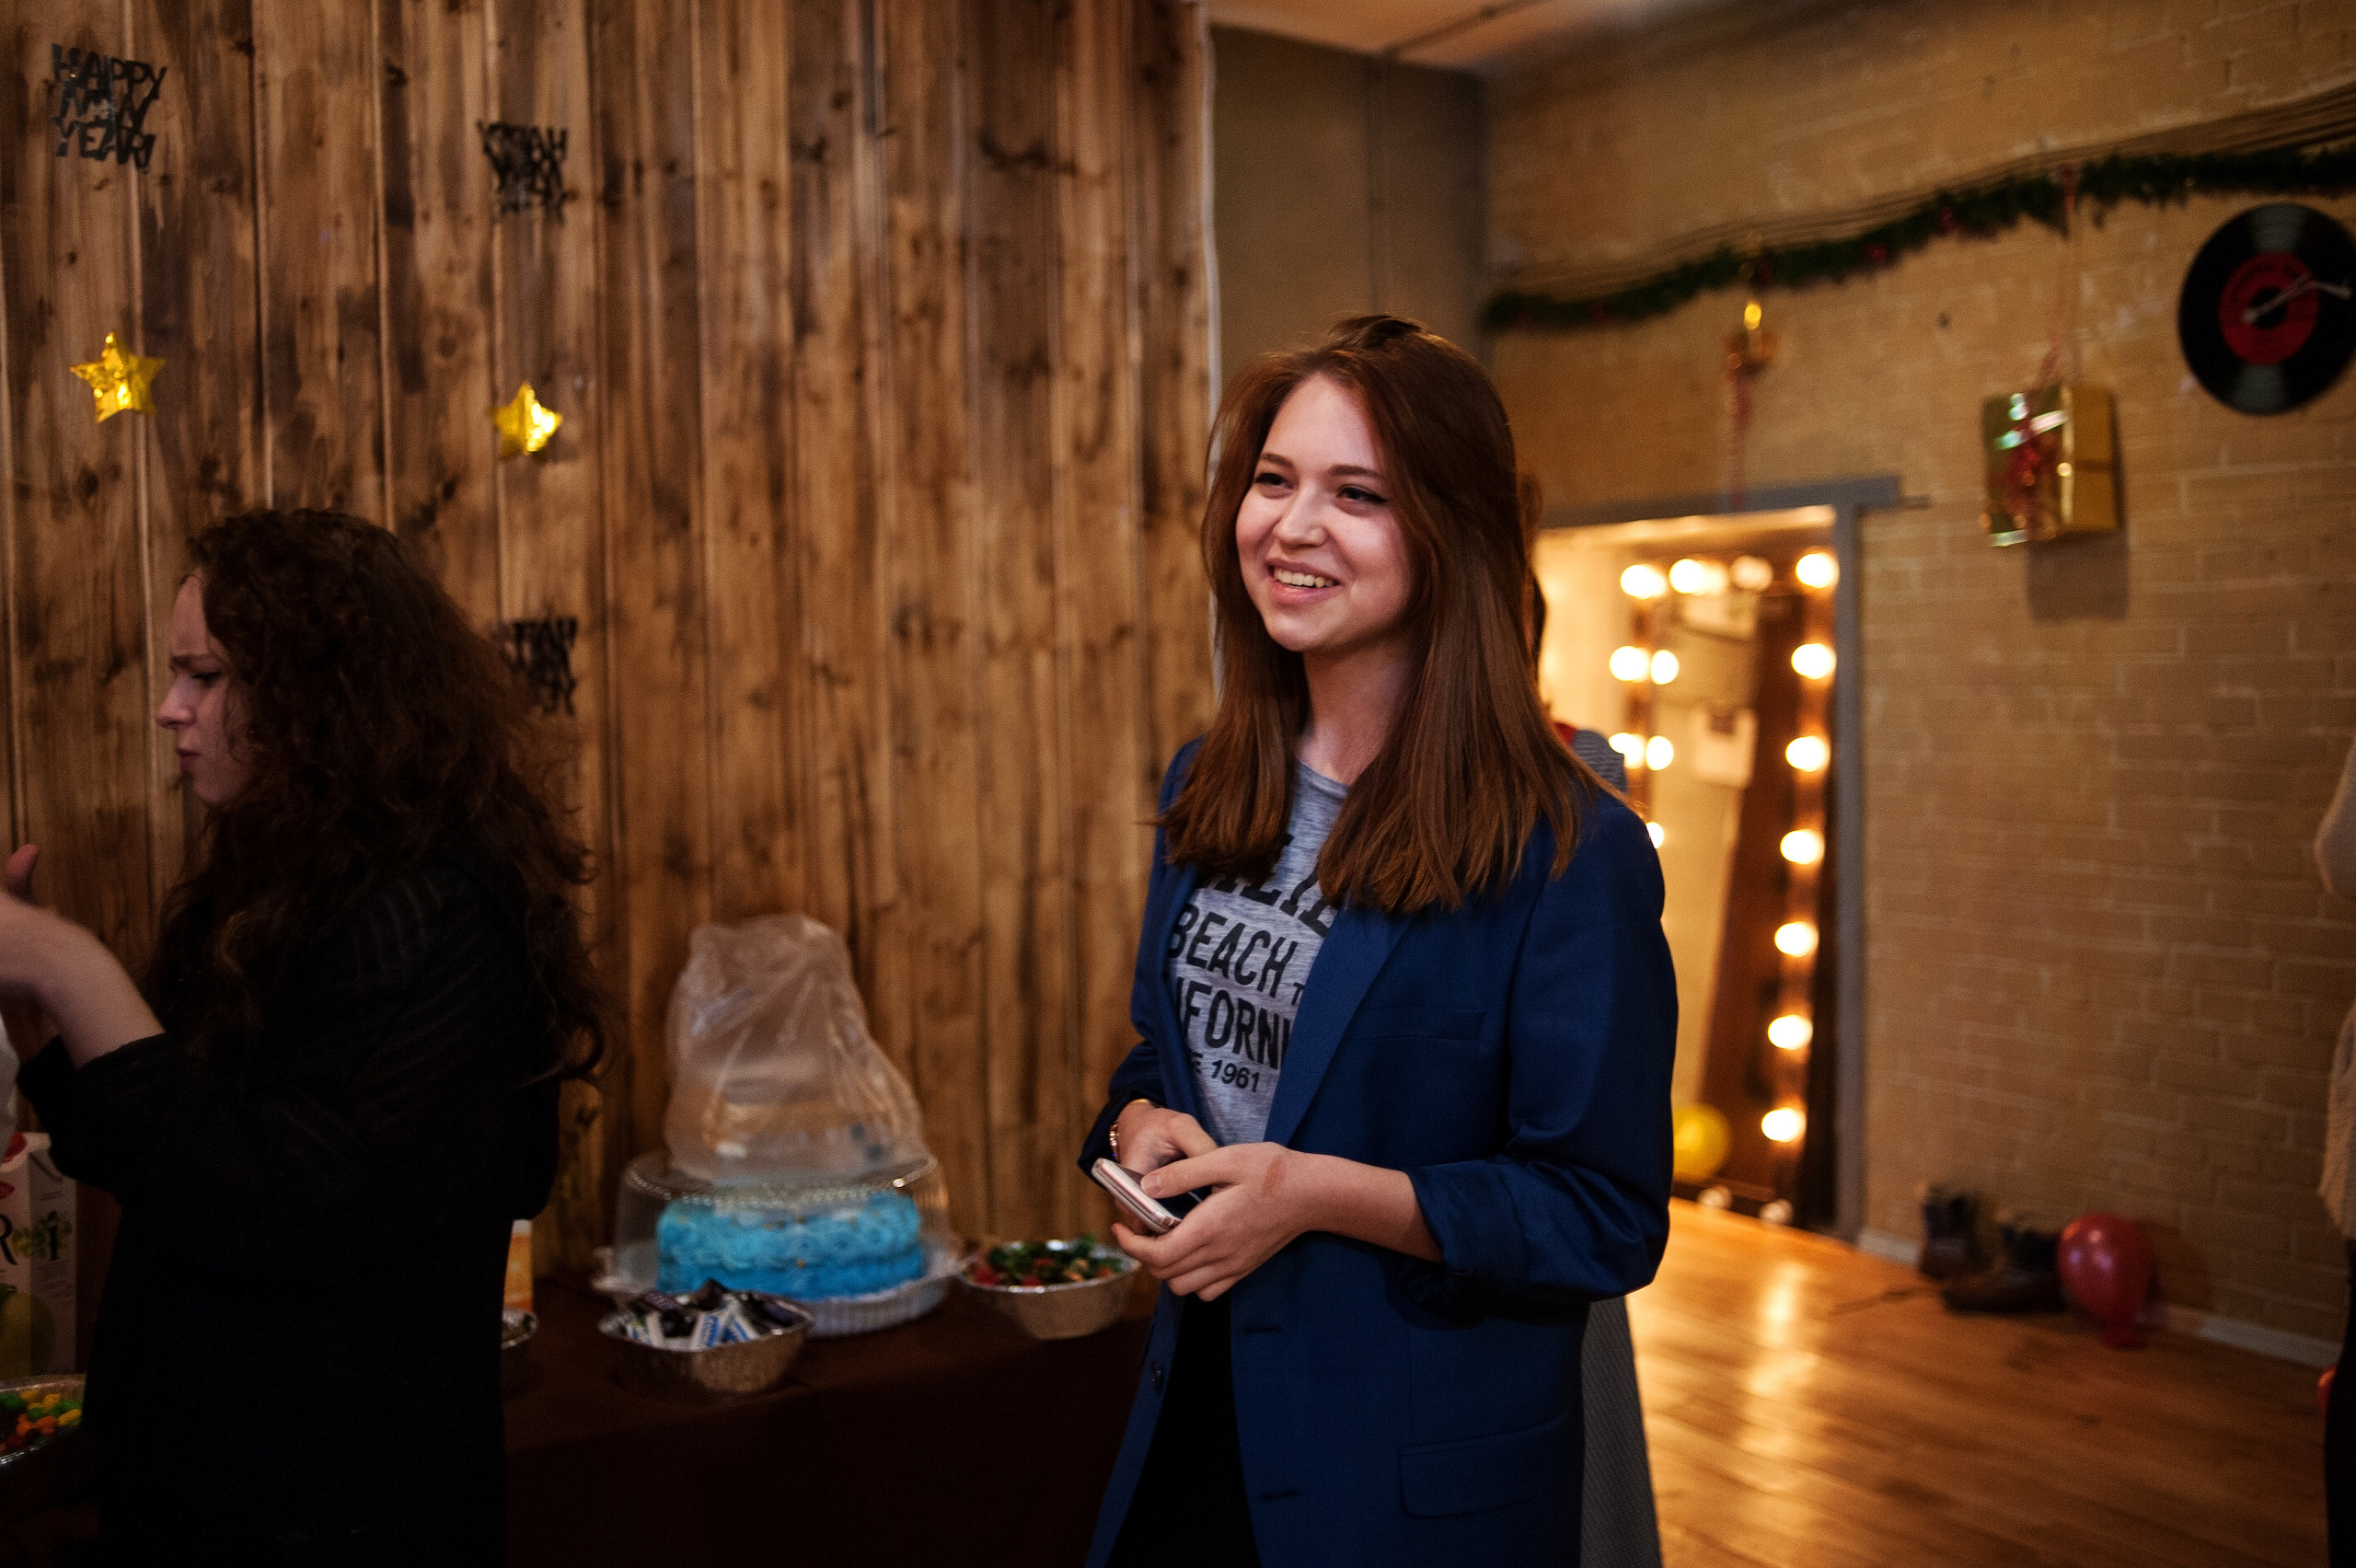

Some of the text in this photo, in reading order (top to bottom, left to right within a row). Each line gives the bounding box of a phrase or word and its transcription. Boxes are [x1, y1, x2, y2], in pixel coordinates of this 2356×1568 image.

[52, 43, 167, 101] HAPPY
[1168, 902, 1297, 997] BEACH
[1211, 1059, 1261, 1092] 1961
